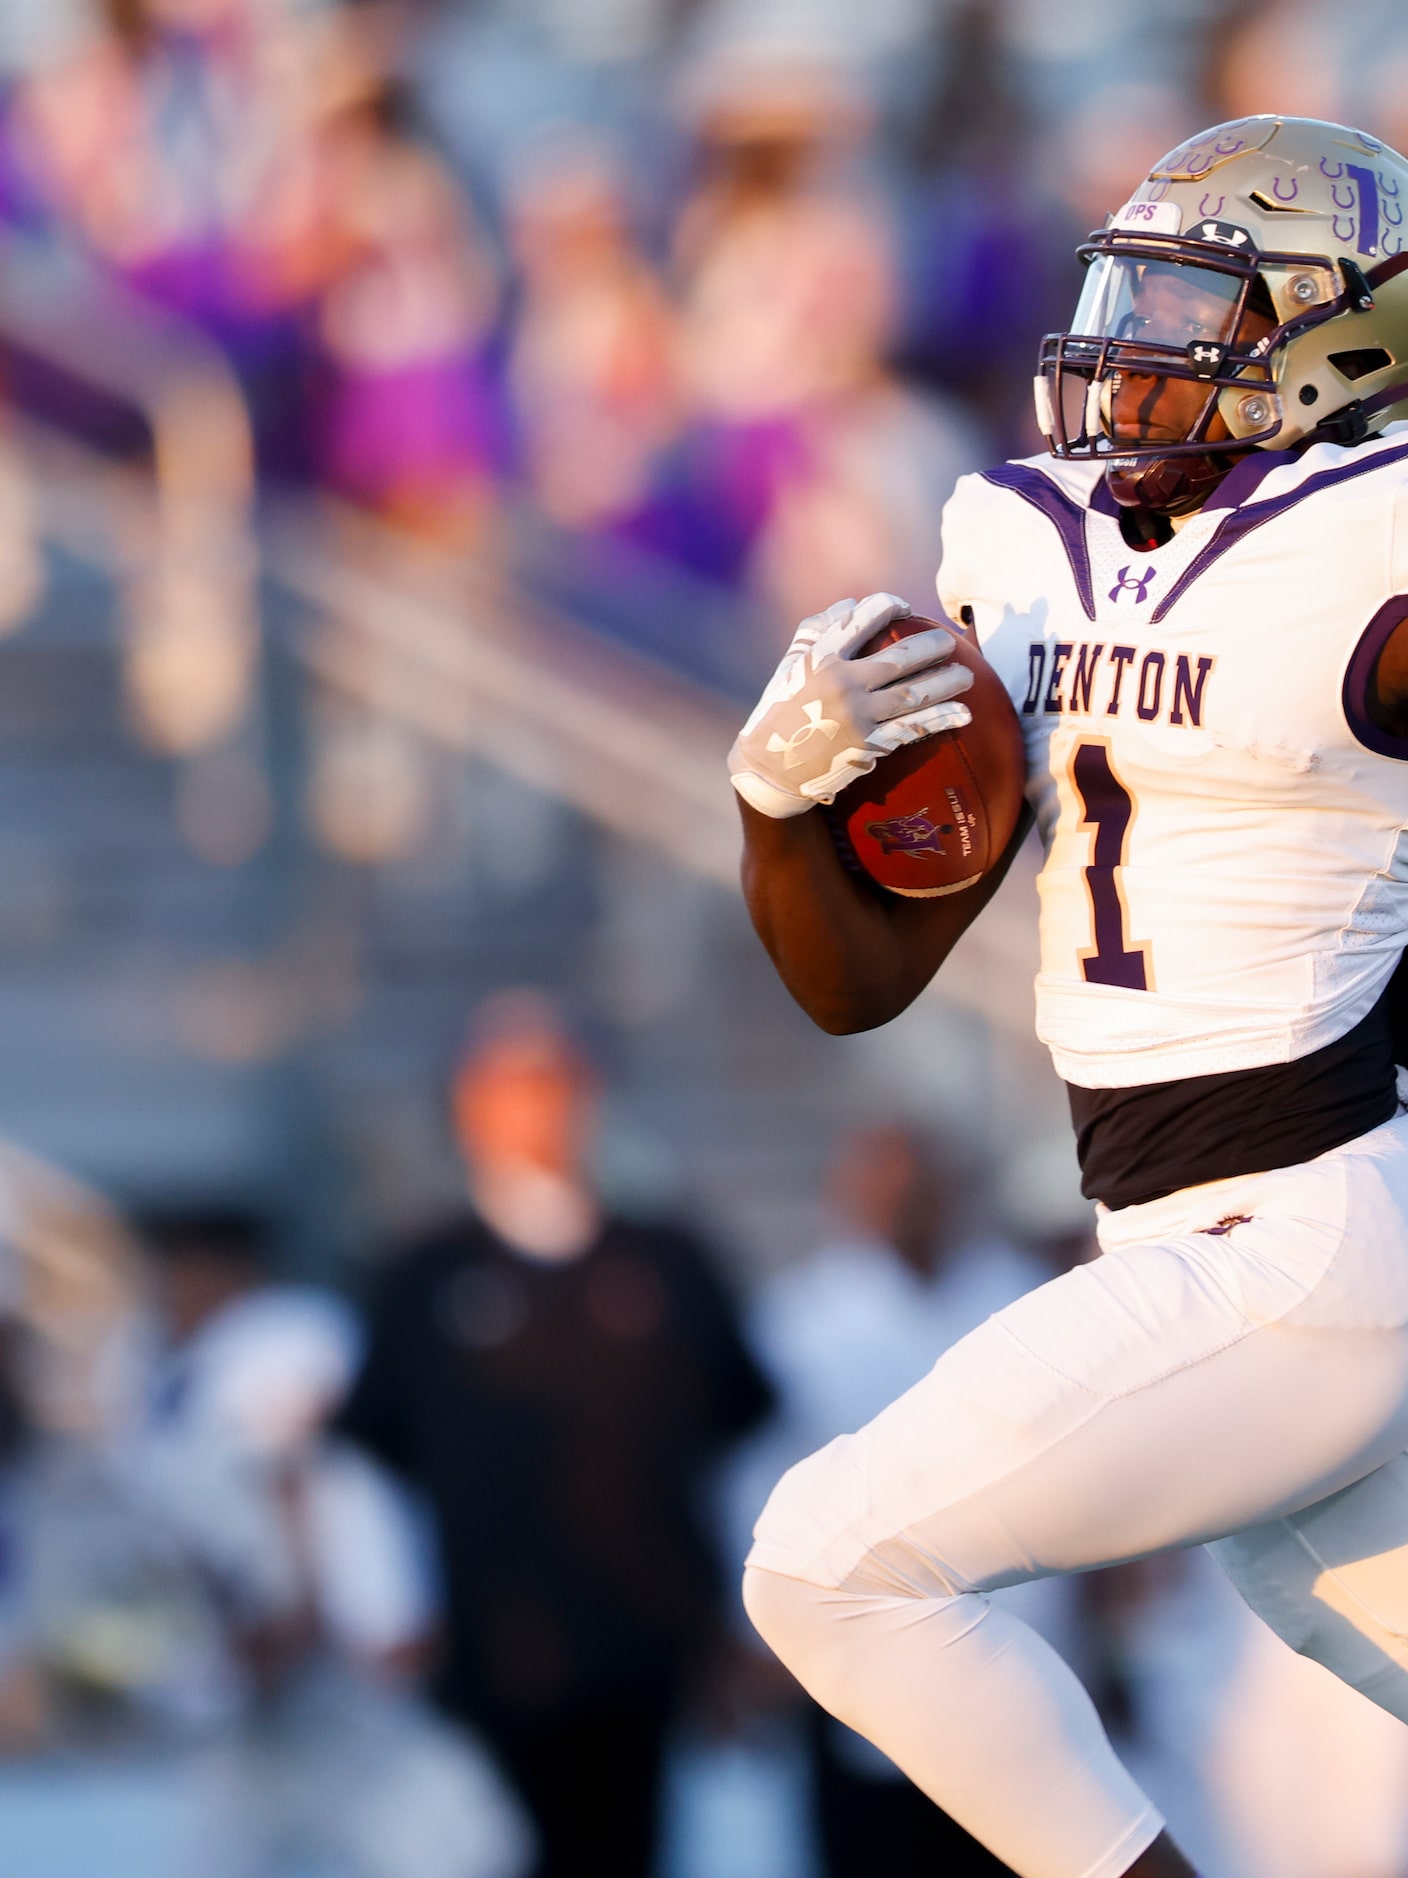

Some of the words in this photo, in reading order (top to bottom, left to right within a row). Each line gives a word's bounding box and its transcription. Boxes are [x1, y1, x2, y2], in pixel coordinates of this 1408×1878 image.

[1023, 643, 1215, 728] DENTON
[944, 786, 967, 824] ISSUE
[958, 825, 973, 857] TEAM
[1069, 737, 1154, 991] 1
